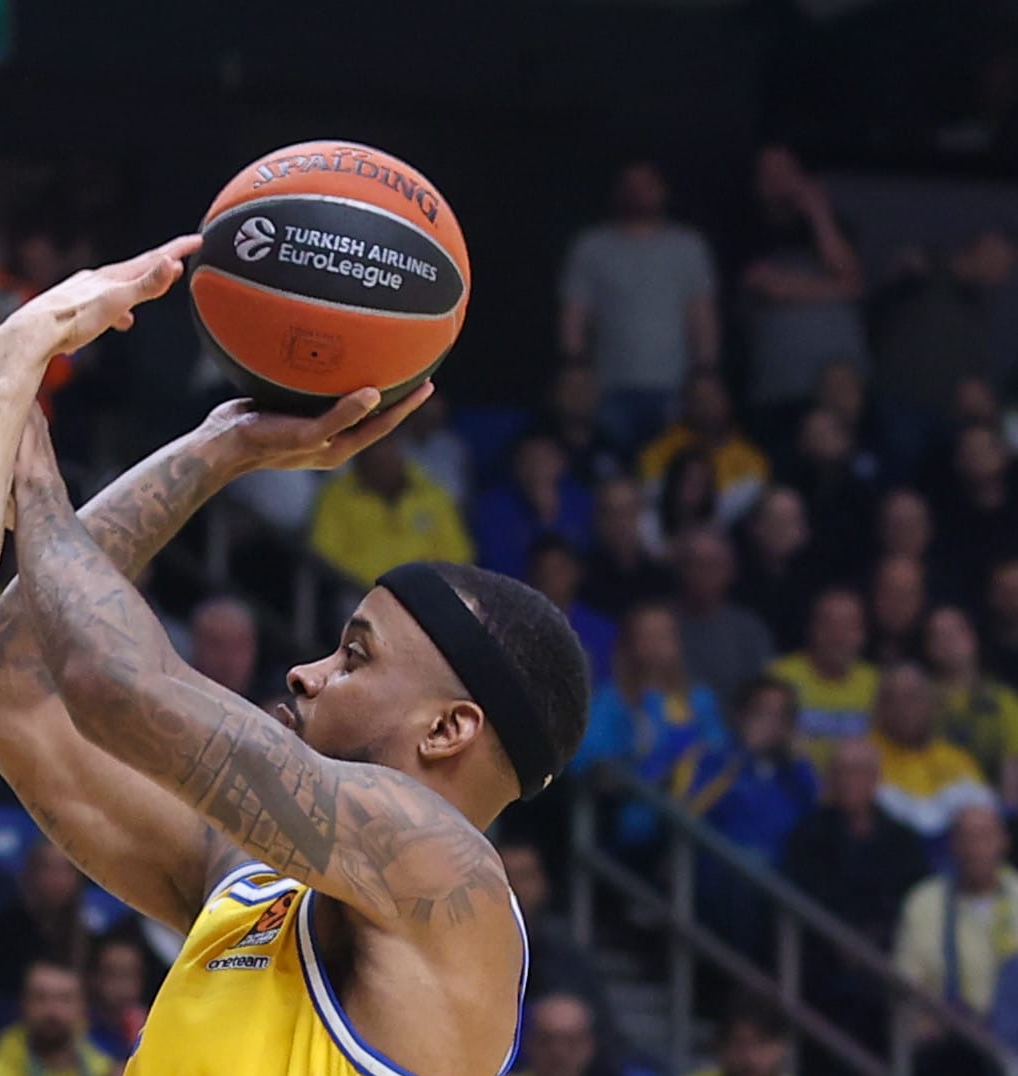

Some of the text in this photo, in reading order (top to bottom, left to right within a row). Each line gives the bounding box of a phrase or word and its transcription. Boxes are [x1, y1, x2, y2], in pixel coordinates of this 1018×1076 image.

[278, 243, 403, 290] EuroLeague
[284, 225, 438, 283] TURKISH AIRLINES
[207, 956, 269, 970] oneteam
